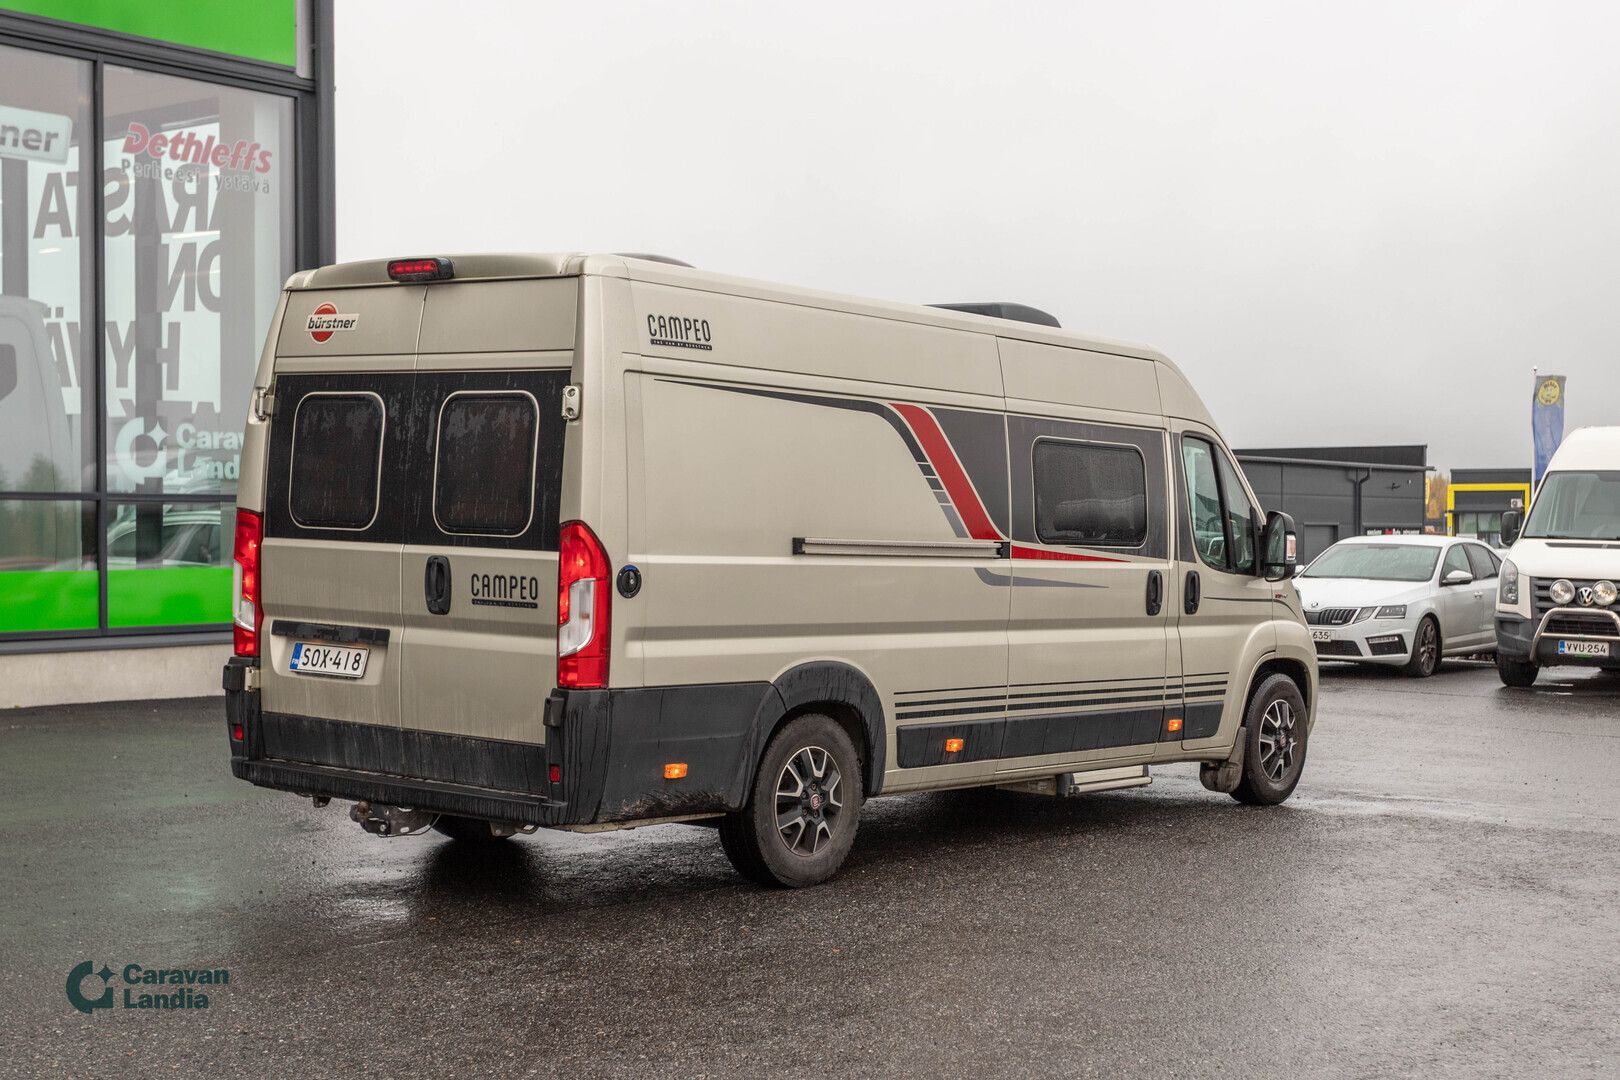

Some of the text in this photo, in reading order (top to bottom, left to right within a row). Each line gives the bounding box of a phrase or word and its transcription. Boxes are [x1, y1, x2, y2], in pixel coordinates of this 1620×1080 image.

[122, 121, 273, 174] Dethleffs
[121, 158, 271, 194] Perheesi ystävä
[307, 317, 356, 330] bürstner
[647, 313, 712, 343] CAMPEO
[471, 573, 538, 601] CAMPEO
[302, 647, 362, 672] SOX-418
[1566, 642, 1607, 654] VVU-254
